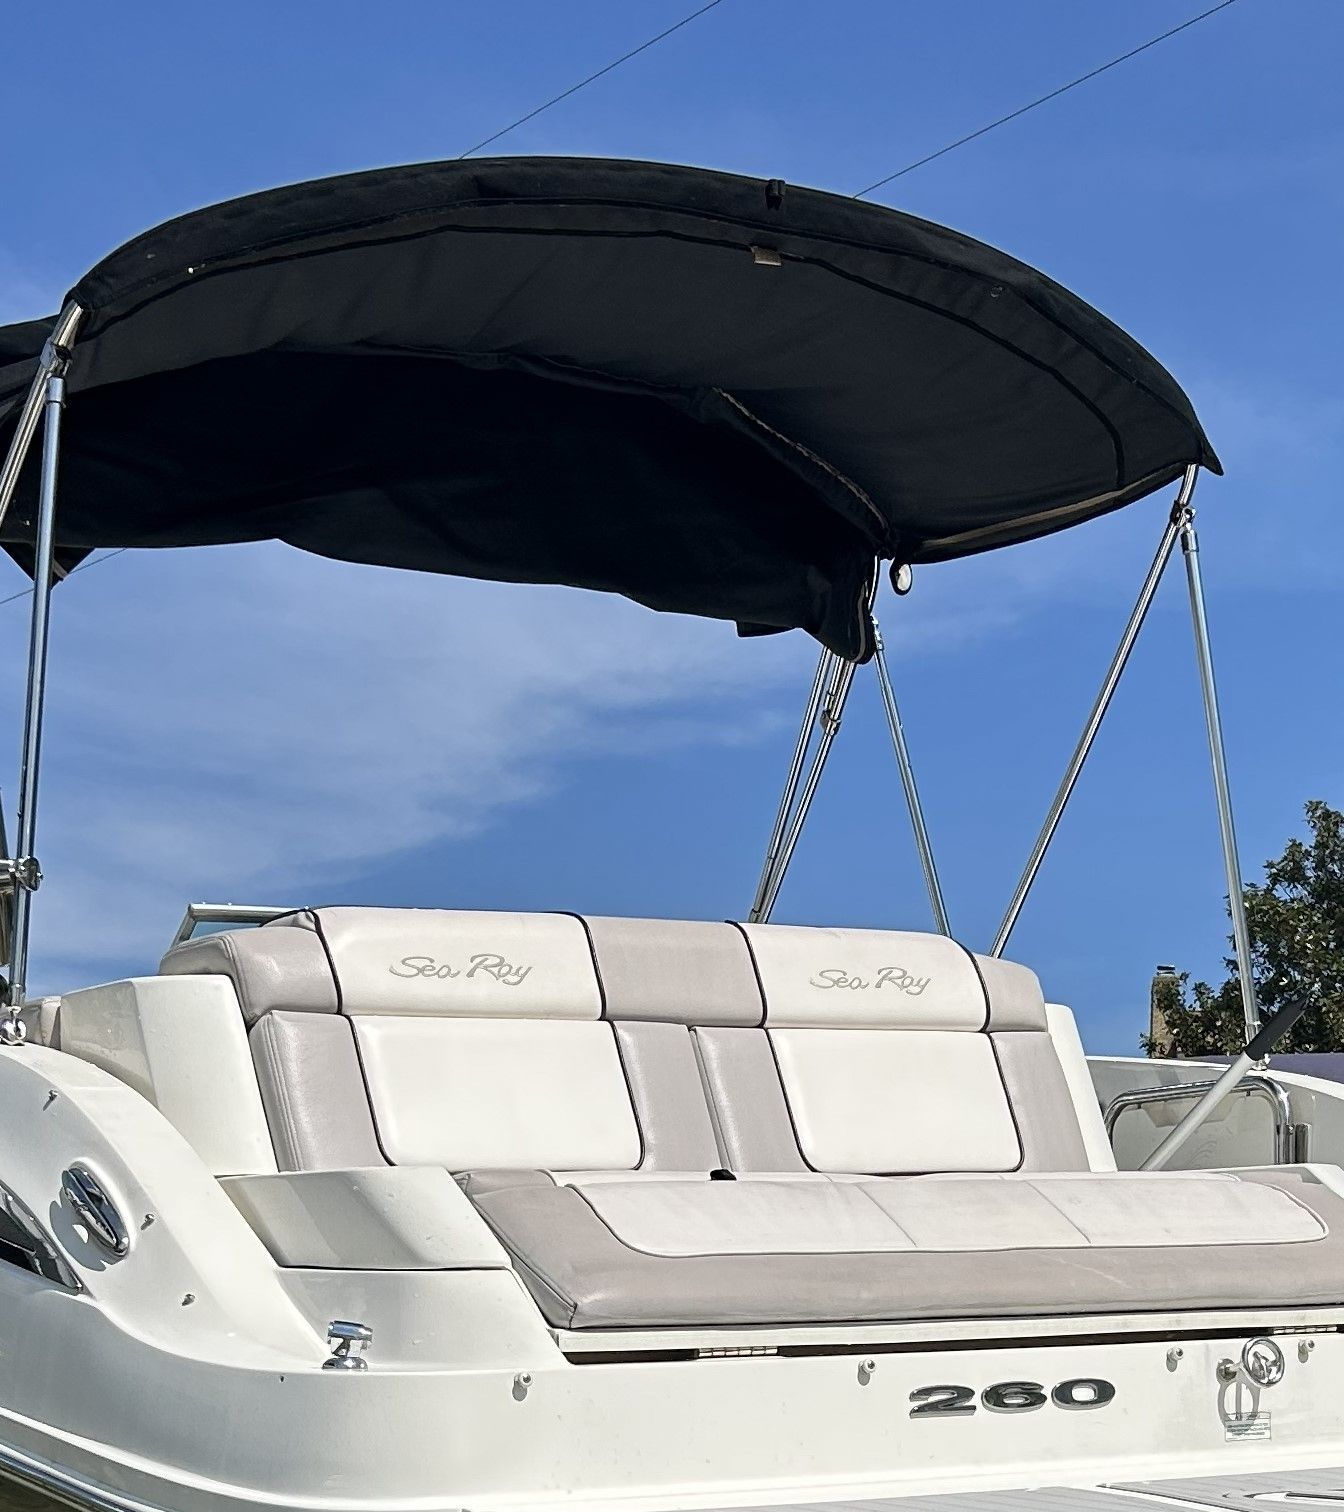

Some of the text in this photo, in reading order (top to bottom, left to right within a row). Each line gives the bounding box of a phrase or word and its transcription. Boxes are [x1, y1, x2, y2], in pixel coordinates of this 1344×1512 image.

[388, 953, 533, 986] Sea Ray
[809, 967, 931, 995] Sea Ray
[909, 1378, 1116, 1419] 260
